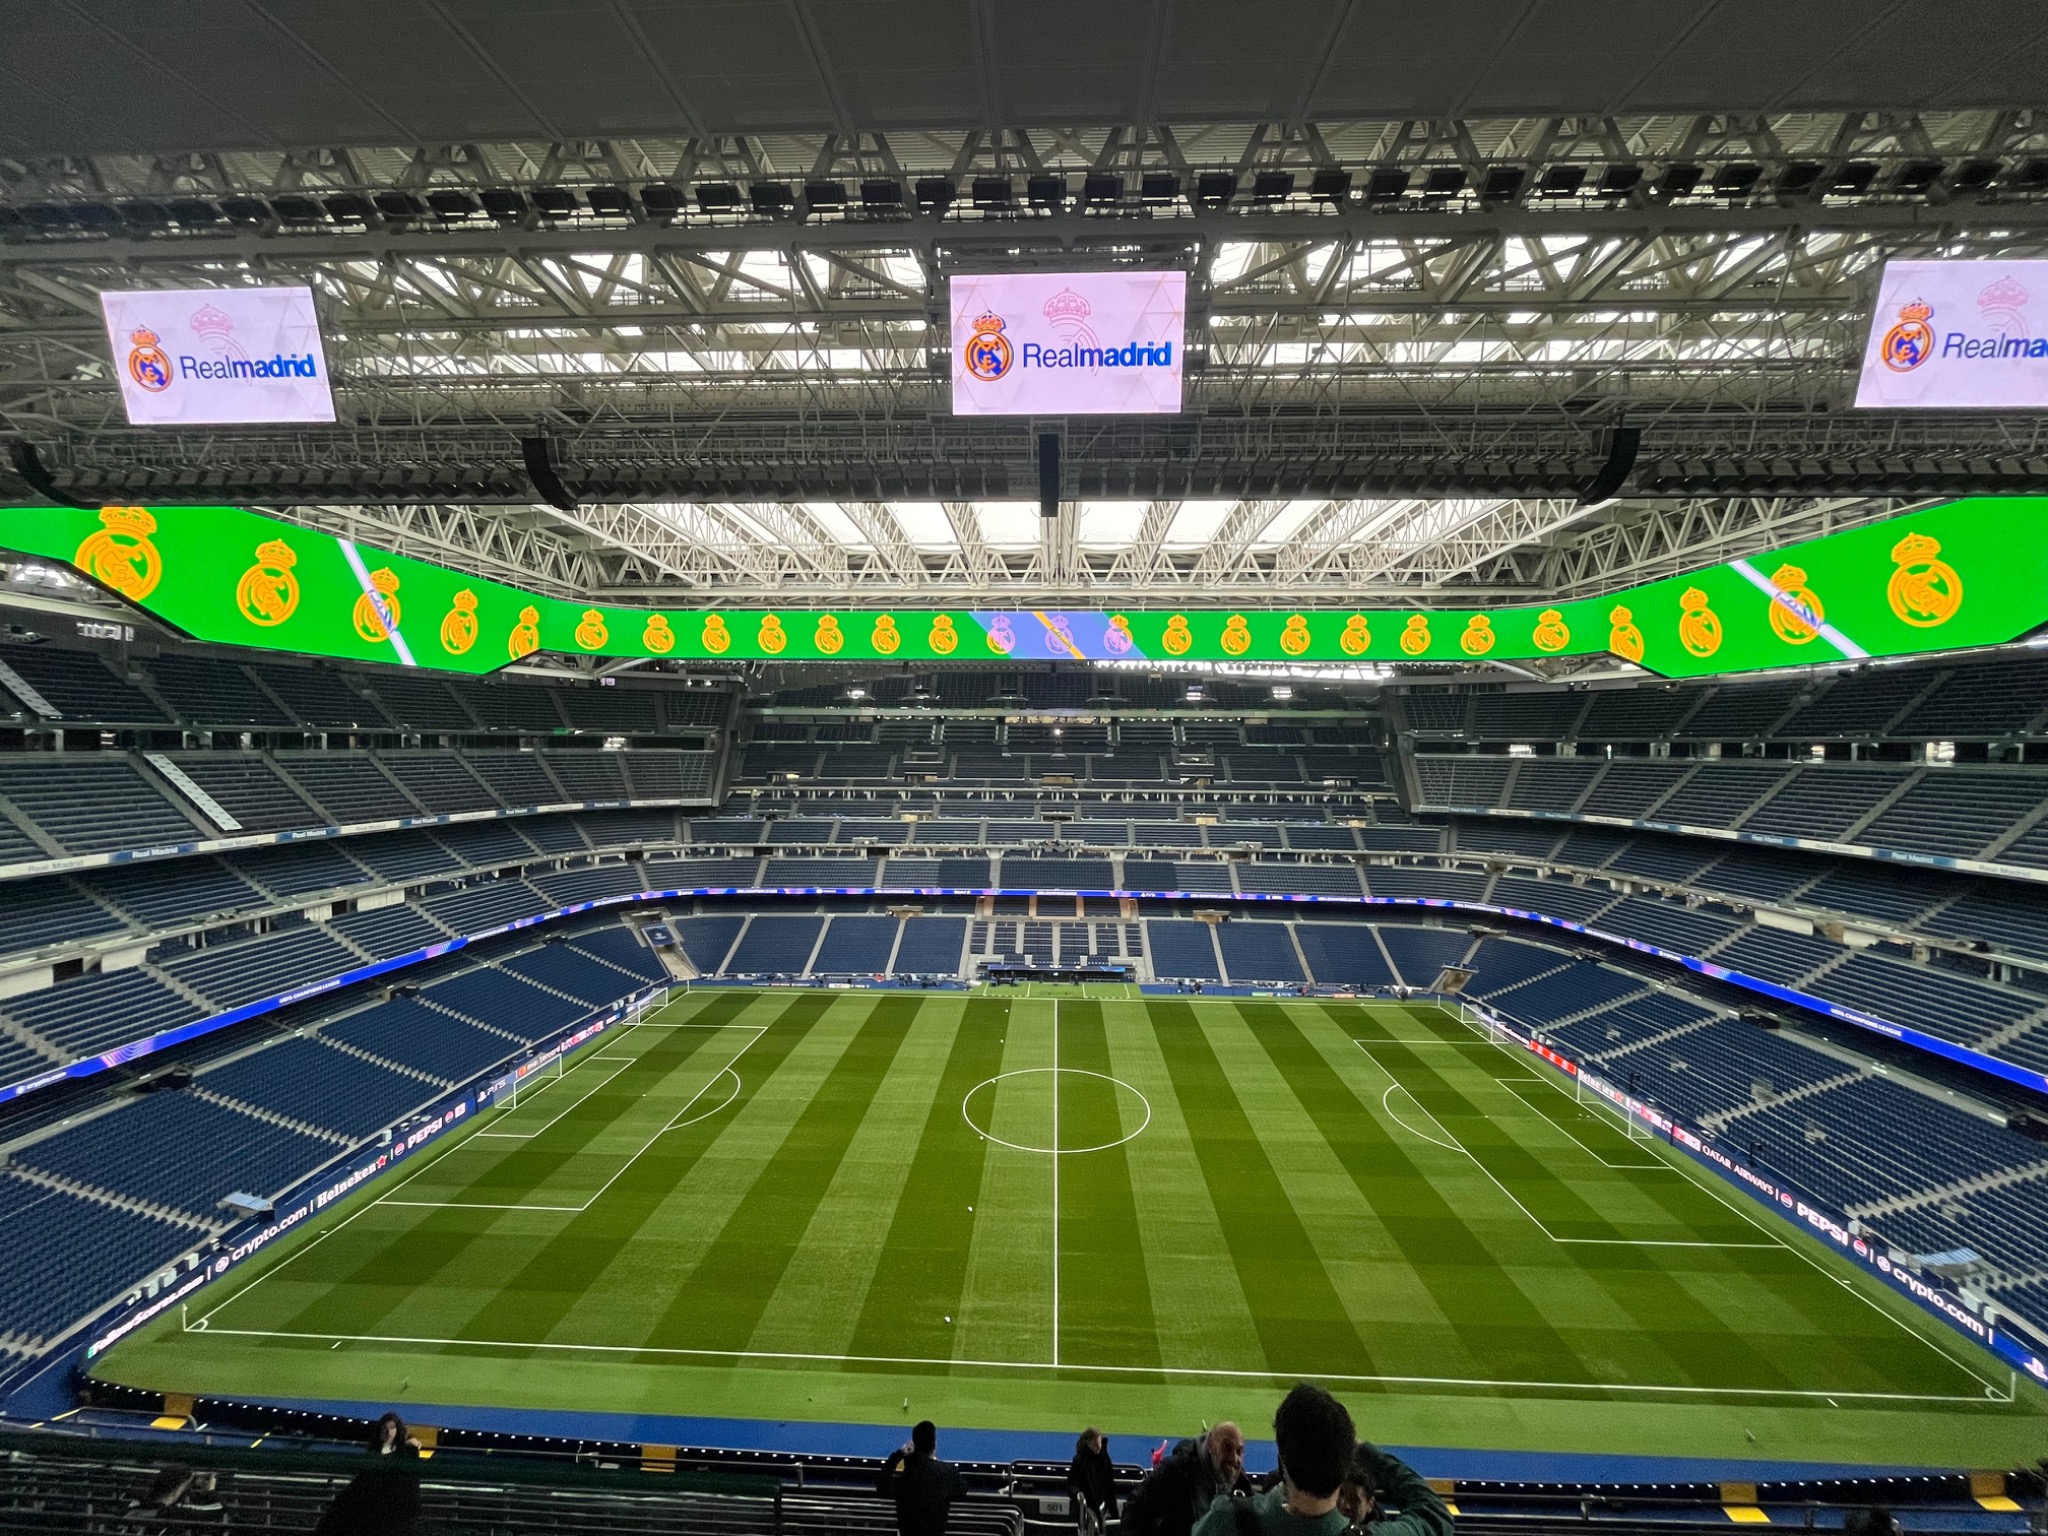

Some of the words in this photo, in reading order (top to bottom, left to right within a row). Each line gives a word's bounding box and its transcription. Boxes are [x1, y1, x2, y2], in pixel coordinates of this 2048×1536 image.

[180, 353, 317, 380] Realmadrid
[1023, 341, 1172, 368] Realmadrid
[1942, 333, 2048, 359] Realma
[407, 1117, 443, 1149] PEPSI
[316, 1162, 377, 1209] Heineken
[1702, 1145, 1732, 1170] QATAR
[1733, 1164, 1774, 1196] AIRWAYS
[231, 1207, 308, 1261] crypto.com
[1797, 1201, 1849, 1246] PEPSI
[1893, 1267, 1984, 1336] crypto.com
